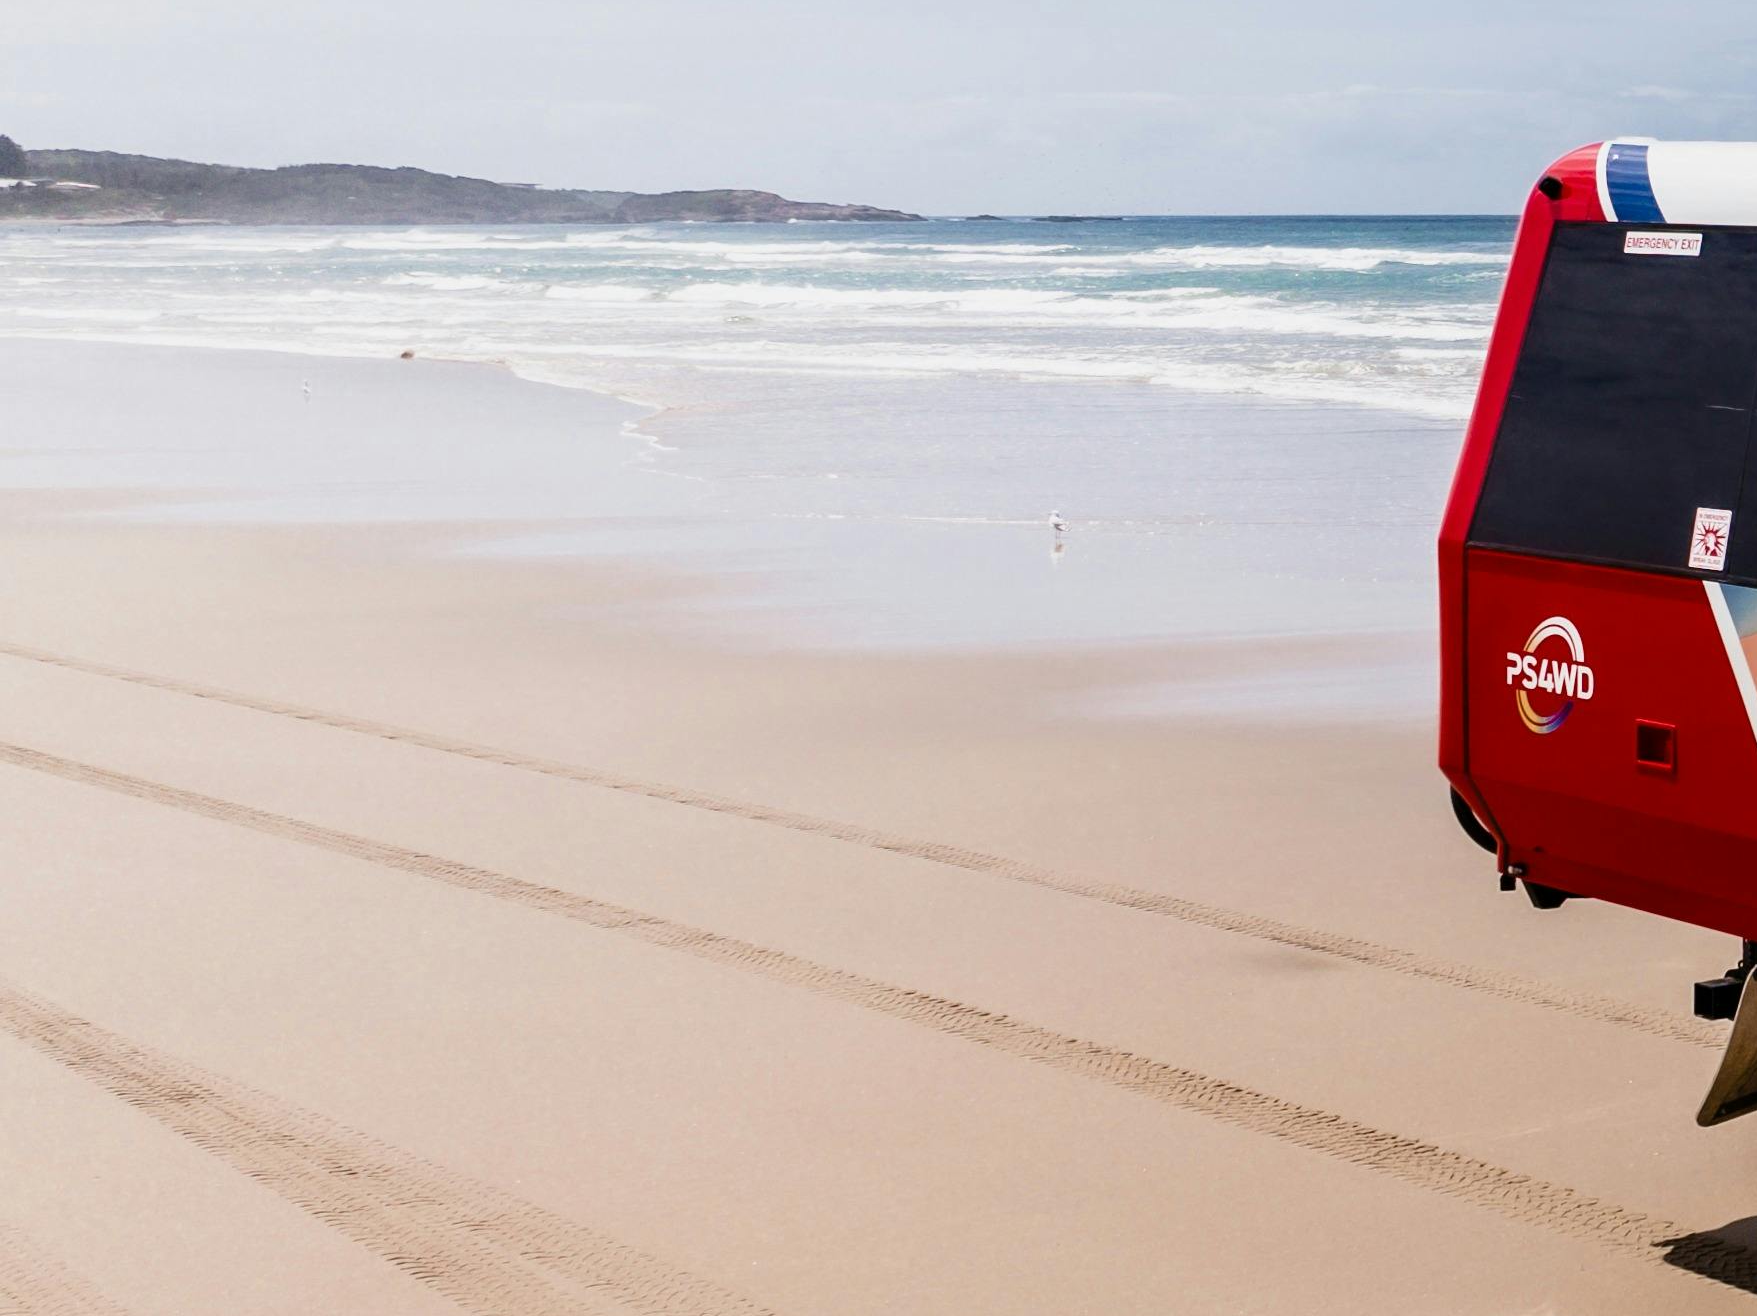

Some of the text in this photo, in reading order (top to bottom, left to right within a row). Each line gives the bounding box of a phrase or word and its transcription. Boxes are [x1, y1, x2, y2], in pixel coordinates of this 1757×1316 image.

[1626, 237, 1700, 250] EMERGENCY EXIT
[1506, 651, 1595, 700] PS4WD
